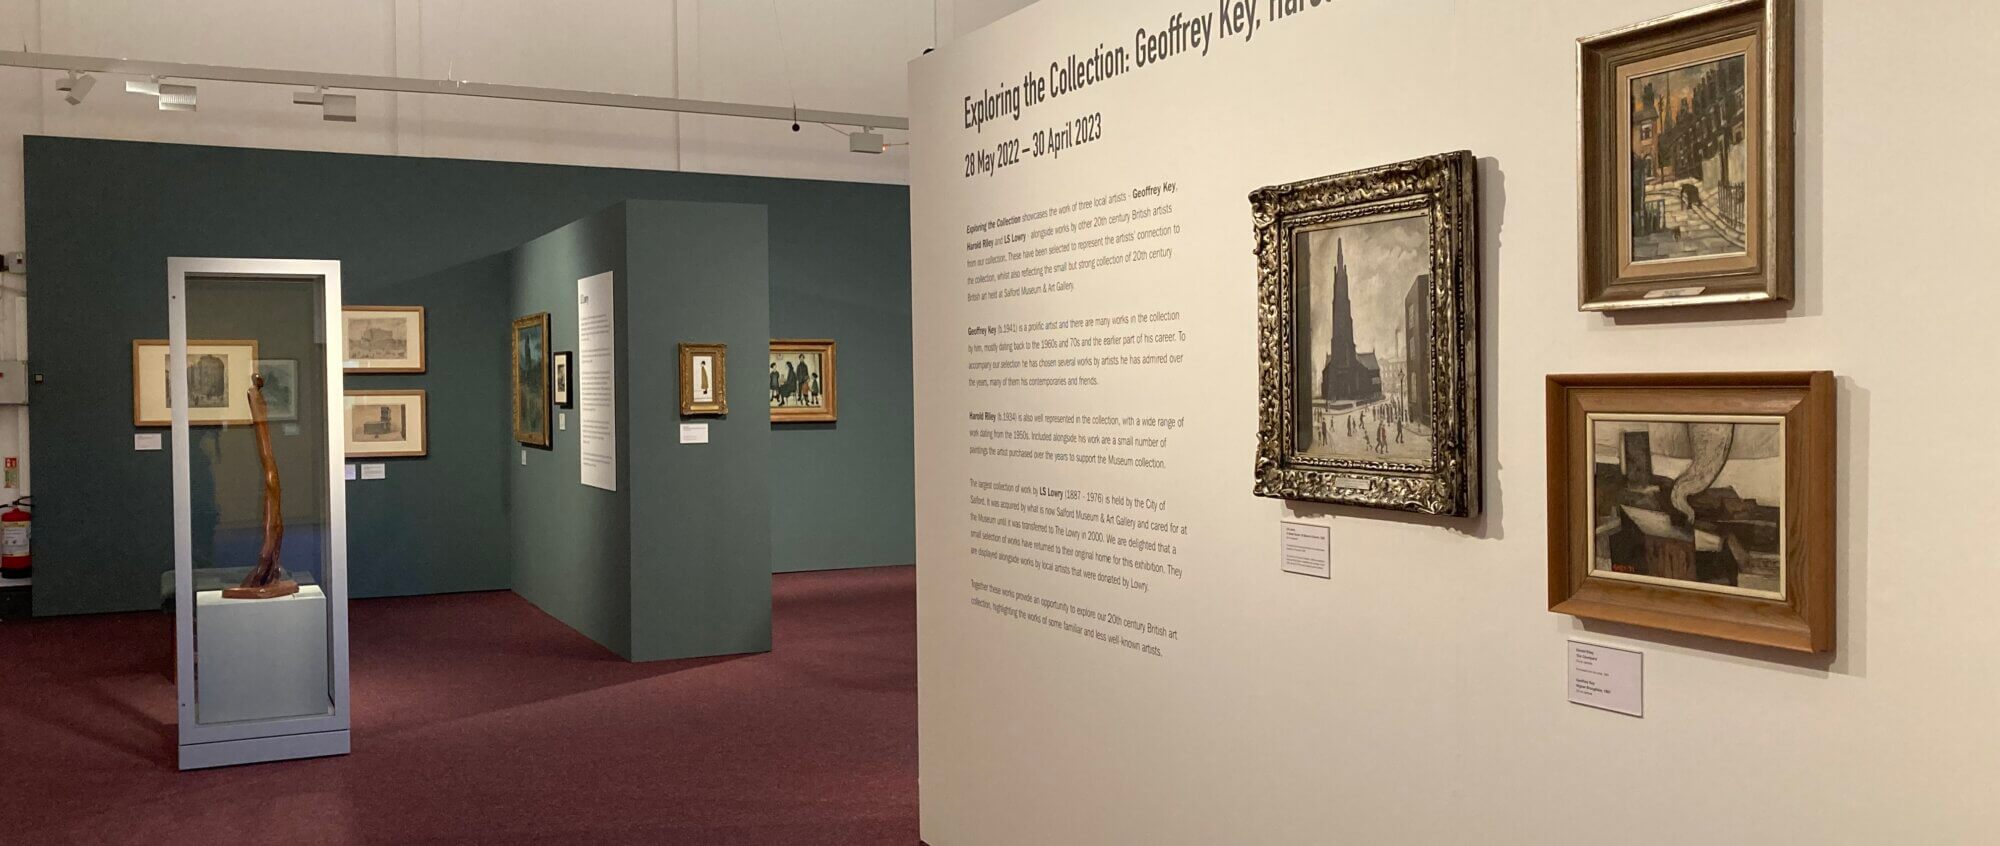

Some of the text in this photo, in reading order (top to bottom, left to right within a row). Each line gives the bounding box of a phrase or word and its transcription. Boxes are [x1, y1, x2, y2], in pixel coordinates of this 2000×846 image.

[964, 82, 1020, 133] Exploring
[1024, 71, 1045, 107] the
[1050, 43, 1130, 98] Collection:
[1136, 12, 1212, 67] Geoffrey
[1220, 0, 1260, 42] Key,
[965, 152, 975, 177] 28
[978, 149, 995, 177] May
[997, 138, 1020, 168] 2022
[1033, 130, 1045, 157] 30
[1048, 121, 1072, 159] April
[1075, 112, 1101, 145] 2023
[966, 223, 986, 234] Exploring
[997, 216, 1020, 227] Collection
[1079, 201, 1092, 210] three
[1094, 196, 1107, 207] local
[1109, 193, 1126, 204] artists
[1132, 186, 1161, 199] Geoffrey
[966, 241, 981, 250] Harold
[983, 240, 993, 248] Riley
[1004, 235, 1010, 243] LS
[1012, 234, 1026, 242] Lowry
[1094, 216, 1107, 227] 20th
[1109, 214, 1130, 224] century
[1132, 208, 1151, 220] British
[1153, 205, 1172, 216] artists
[1078, 238, 1103, 251] represent
[1105, 236, 1114, 245] the
[1137, 227, 1171, 240] connection
[1174, 226, 1180, 234] to
[1079, 260, 1095, 269] strong
[1096, 255, 1123, 266] collection
[1125, 252, 1131, 262] of
[1132, 250, 1147, 261] 20th
[1149, 248, 1172, 259] century
[968, 327, 987, 336] Geoffrey
[988, 326, 996, 335] Key
[1095, 318, 1110, 327] many
[1112, 315, 1129, 324] works
[1130, 315, 1136, 323] in
[1138, 314, 1147, 323] the
[1150, 312, 1179, 322] collection
[1082, 337, 1091, 346] and
[1093, 337, 1102, 346] the
[1103, 336, 1121, 345] earlier
[1123, 335, 1135, 346] part
[1137, 334, 1143, 343] of
[1144, 333, 1153, 343] his
[1178, 331, 1186, 341] To
[1094, 357, 1100, 367] by
[1101, 356, 1119, 365] artists
[1120, 356, 1128, 364] he
[1130, 355, 1141, 364] has
[1142, 354, 1168, 364] admired
[985, 412, 996, 422] Riley
[1082, 415, 1090, 424] the
[1122, 416, 1134, 425] with
[1142, 416, 1156, 426] wide
[1158, 419, 1175, 429] range
[1177, 417, 1184, 427] of
[1088, 435, 1100, 444] work
[1118, 436, 1133, 445] small
[1135, 437, 1158, 447] number
[1160, 438, 1166, 447] of
[1076, 455, 1096, 465] support
[1098, 455, 1106, 464] the
[1108, 455, 1133, 466] Museum
[1040, 487, 1046, 496] LS
[1048, 488, 1063, 500] Lowry
[1105, 494, 1110, 504] is
[1112, 495, 1124, 505] held
[1126, 497, 1132, 509] by
[1134, 498, 1144, 508] the
[1146, 499, 1157, 512] City
[1159, 501, 1166, 510] of
[1076, 510, 1099, 522] Museum
[1100, 513, 1104, 522] &
[1106, 514, 1114, 524] Art
[1115, 515, 1136, 529] Gallery
[1137, 519, 1149, 529] and
[1151, 522, 1168, 532] cared
[1170, 523, 1179, 533] for
[1180, 525, 1187, 534] at
[1106, 534, 1116, 544] We
[1128, 538, 1156, 551] delighted
[1158, 543, 1170, 553] that
[1095, 552, 1111, 563] home
[1122, 557, 1133, 567] this
[1167, 564, 1182, 579] They
[1083, 571, 1096, 580] were
[1098, 572, 1120, 585] donated
[1122, 577, 1129, 589] by
[1077, 607, 1096, 619] explore
[1097, 612, 1106, 621] our
[1108, 613, 1122, 625] 20th
[1123, 619, 1145, 634] century
[1148, 623, 1166, 637] British
[1168, 630, 1177, 639] art
[1084, 629, 1094, 638] and
[1096, 630, 1106, 641] less
